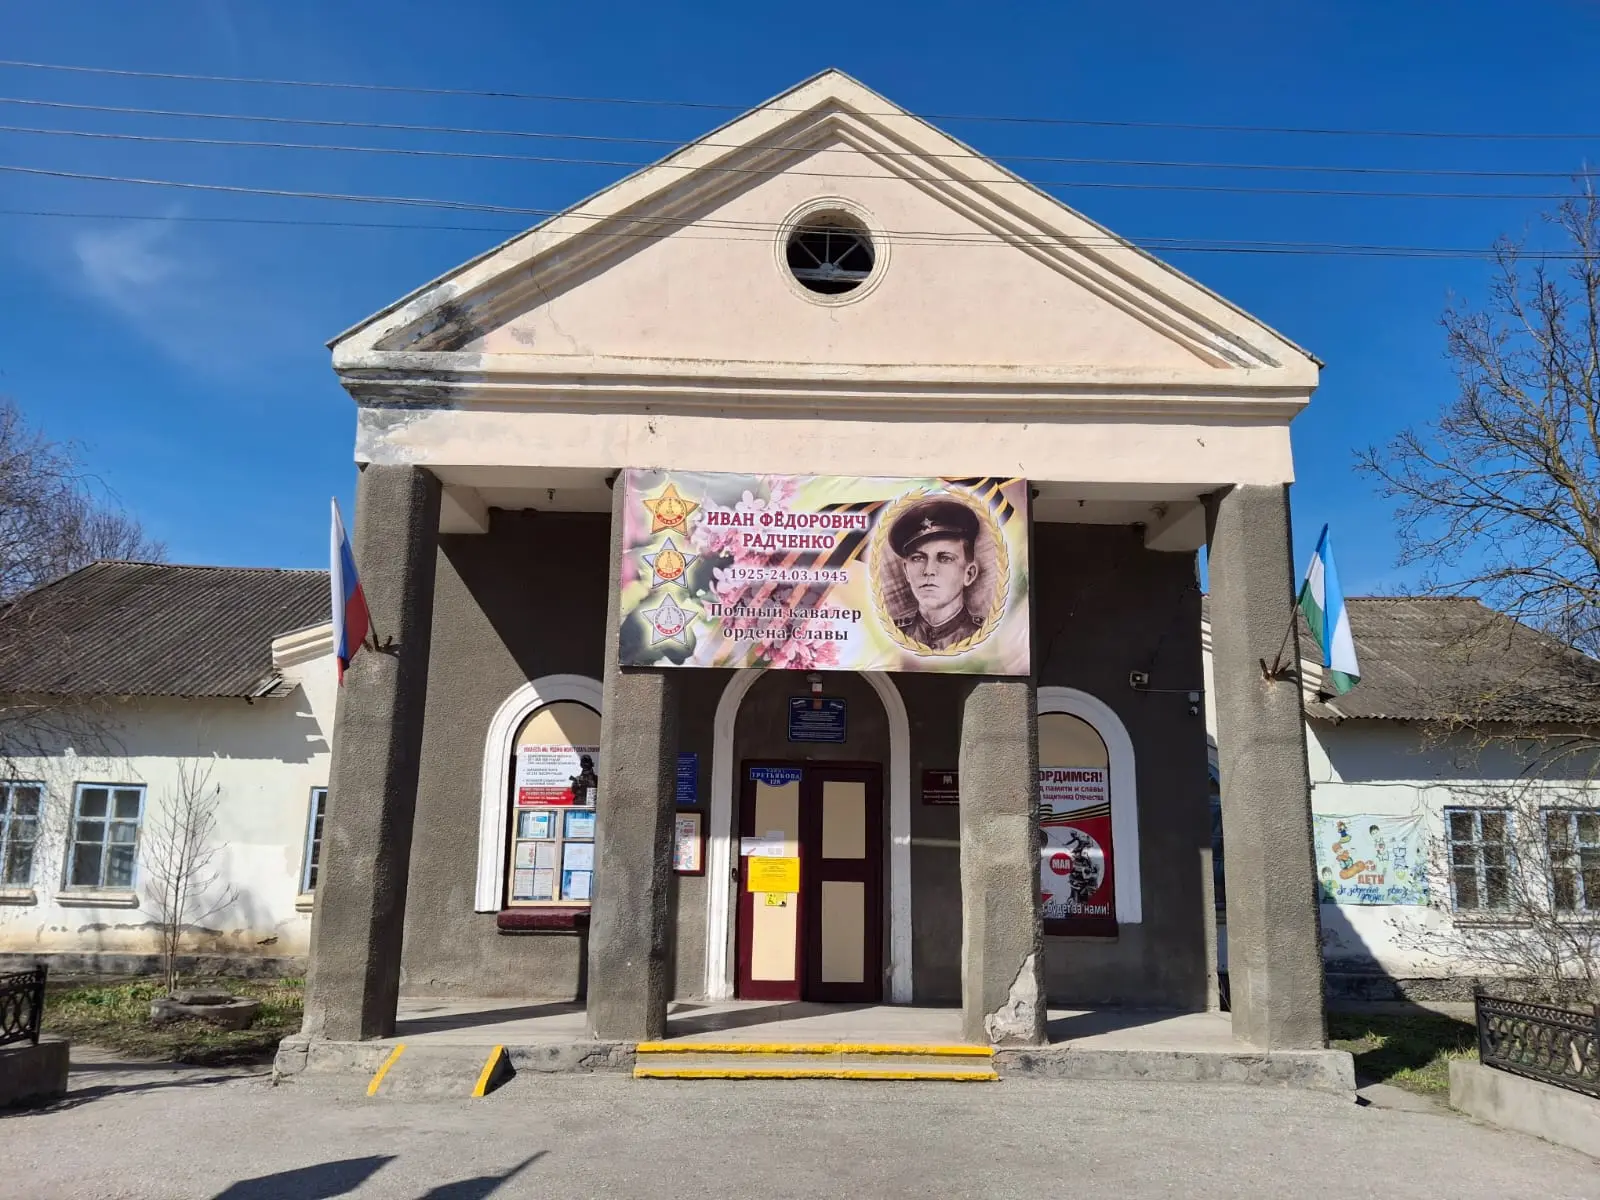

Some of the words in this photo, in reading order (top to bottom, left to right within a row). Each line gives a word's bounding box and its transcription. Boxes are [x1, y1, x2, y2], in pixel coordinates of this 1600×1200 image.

[707, 511, 754, 526] ИВАН
[760, 511, 867, 530] ФЁДОРОВИЧ
[743, 533, 835, 550] РАДЧЕНКО
[731, 568, 848, 582] 1925-24.03.1945
[711, 603, 782, 618] Полный
[789, 608, 861, 623] кавалер
[723, 627, 786, 641] ордена
[792, 626, 849, 641] Славы
[752, 771, 800, 780] ТРЕТЬЯКОВА
[1038, 770, 1103, 783] ОРДИМСЯ!
[1052, 859, 1071, 869] МАЯ
[1357, 874, 1384, 885] ДЕТИ
[1048, 900, 1071, 916] будет
[1084, 901, 1110, 915] нами!
